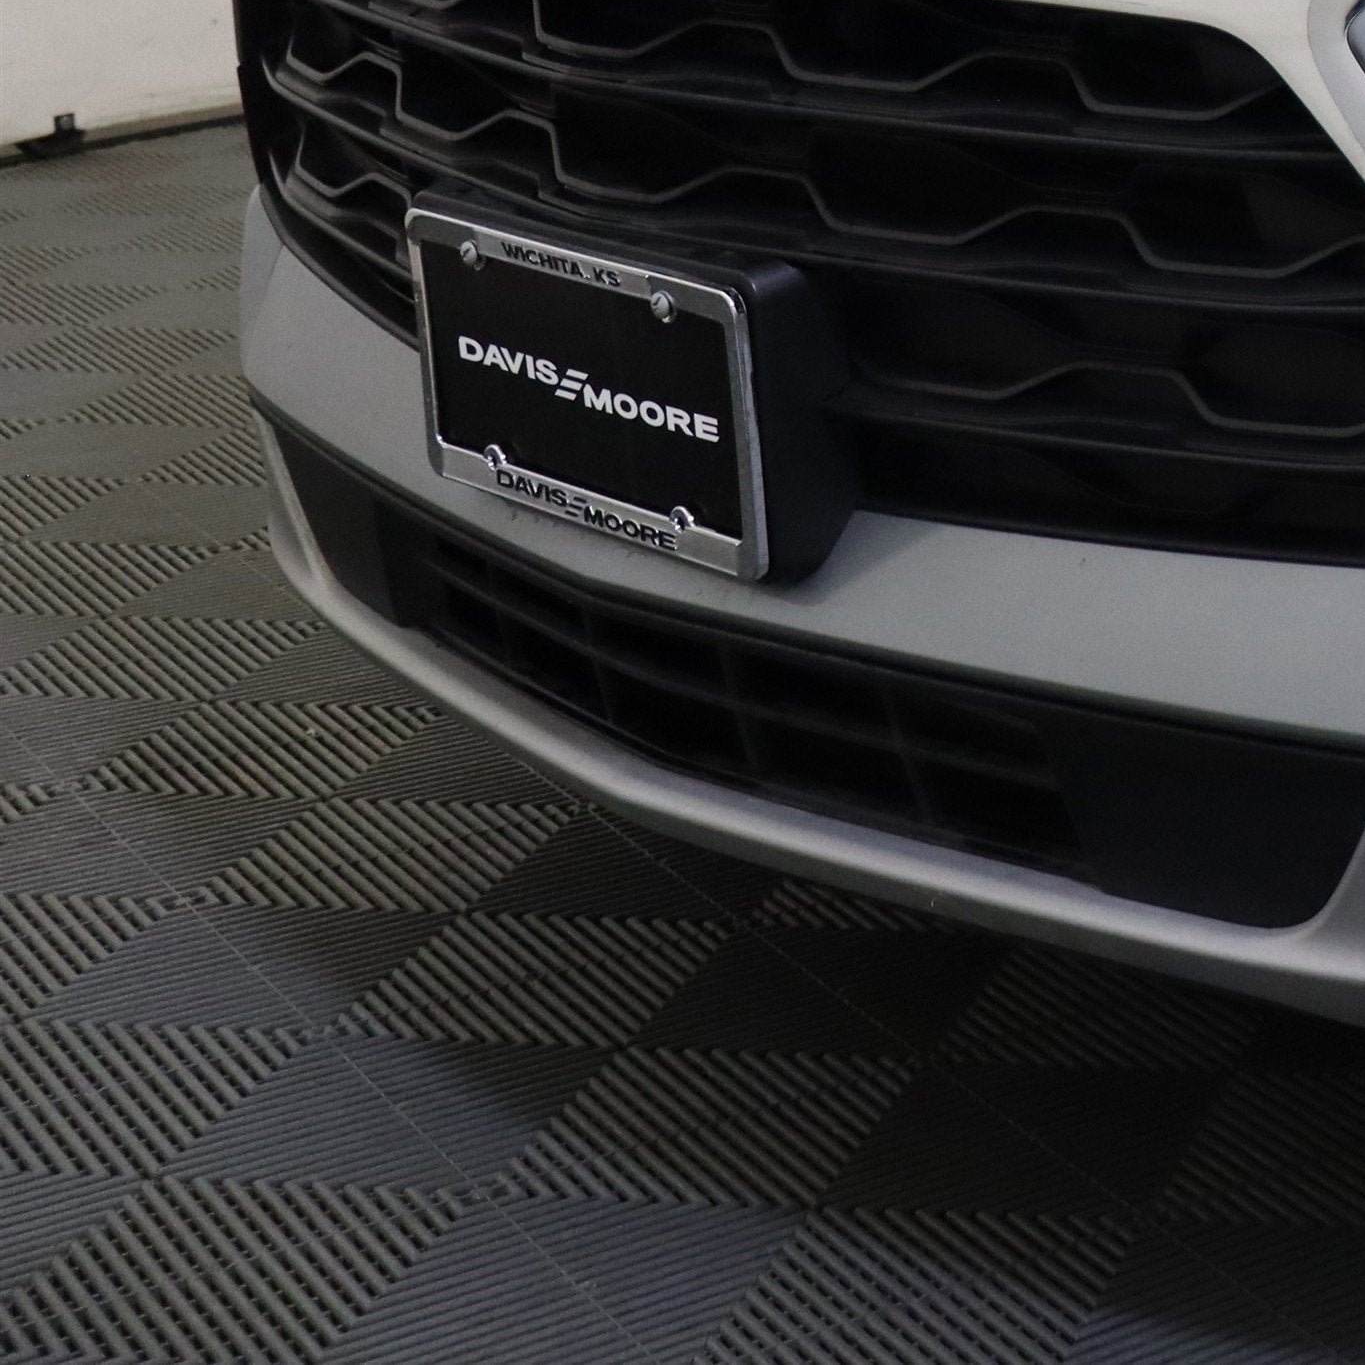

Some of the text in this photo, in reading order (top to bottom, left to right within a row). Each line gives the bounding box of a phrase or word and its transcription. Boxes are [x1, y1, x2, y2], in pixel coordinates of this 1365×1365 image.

[592, 266, 621, 287] KS
[458, 335, 721, 443] DAVIS MOORE
[495, 469, 678, 552] DAVIS MOORE
